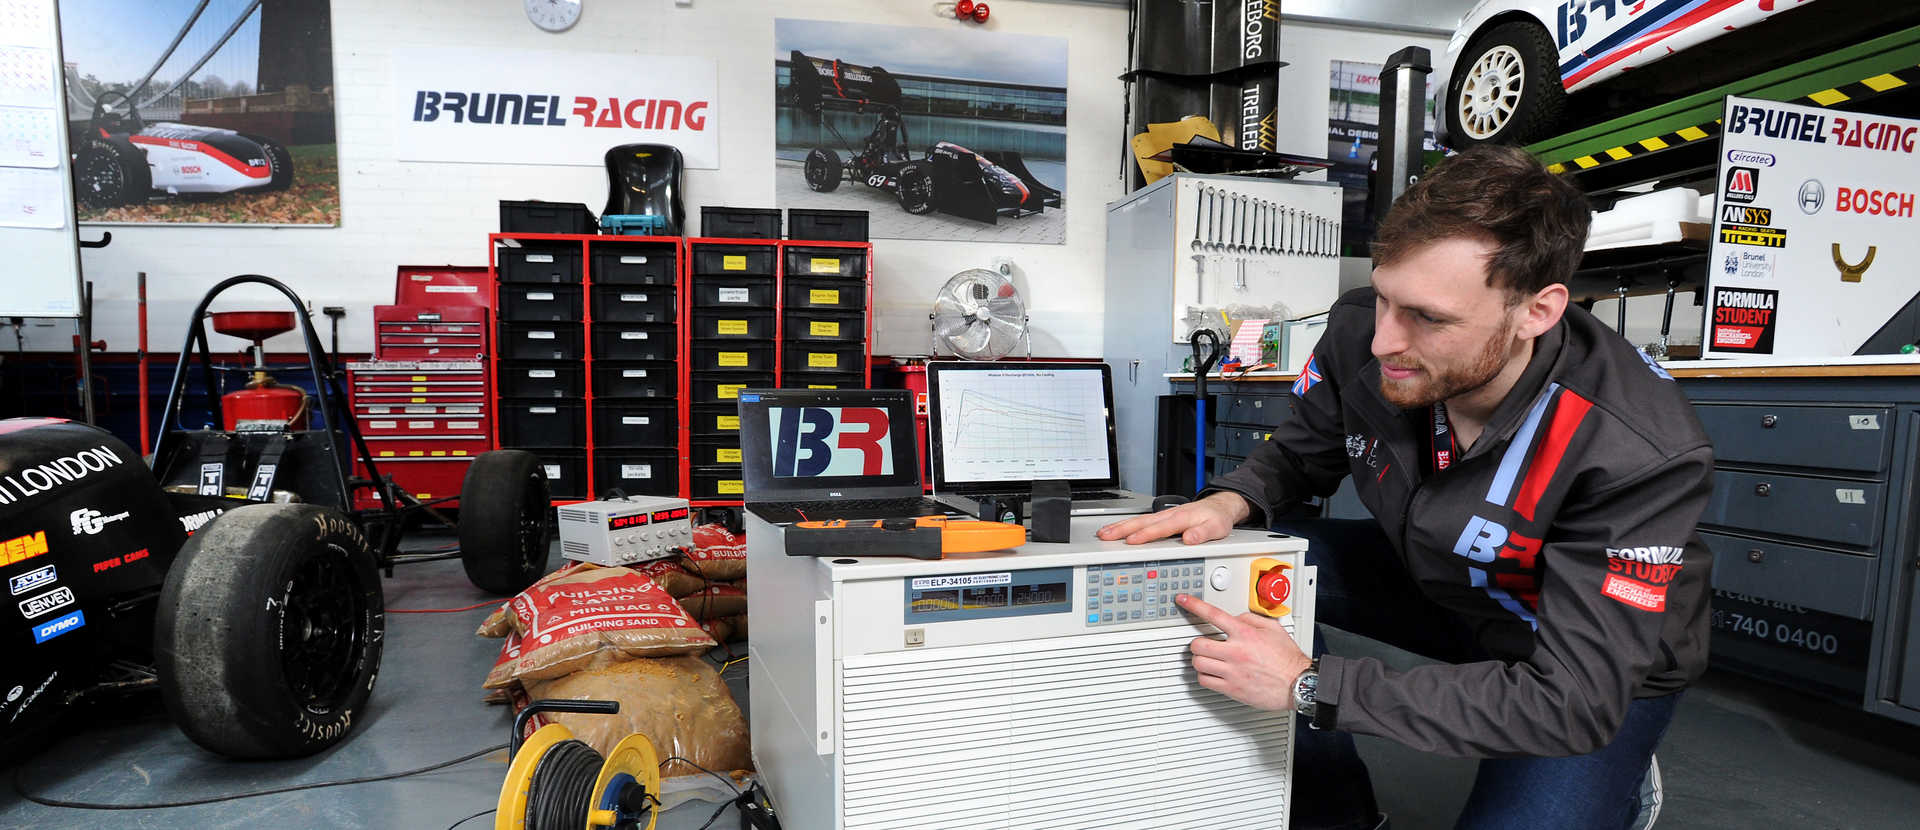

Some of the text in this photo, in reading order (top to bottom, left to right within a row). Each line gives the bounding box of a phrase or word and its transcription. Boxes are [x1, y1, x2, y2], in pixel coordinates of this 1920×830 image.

[413, 91, 709, 131] BRUNEL RACING
[1728, 105, 1918, 153] BRUNEL RACING
[1734, 152, 1770, 164] zircotec
[868, 174, 886, 187] 69
[1836, 187, 1915, 218] BOSCH
[1723, 206, 1770, 225] ANSYS
[1721, 229, 1786, 248] TILLETT
[1743, 252, 1766, 261] Brunel
[1717, 291, 1774, 309] FORMULA
[1715, 307, 1772, 325] STUDENT
[774, 407, 890, 477] BR
[22, 445, 123, 497] LONDON
[930, 577, 972, 587] ELP-34105
[26, 590, 71, 615] JENVEY
[571, 595, 635, 605] SAND
[569, 603, 652, 617] MINI BAG
[41, 616, 79, 637] DYMO
[567, 618, 659, 634] BUILDING SAND
[1776, 624, 1839, 655] 0400
